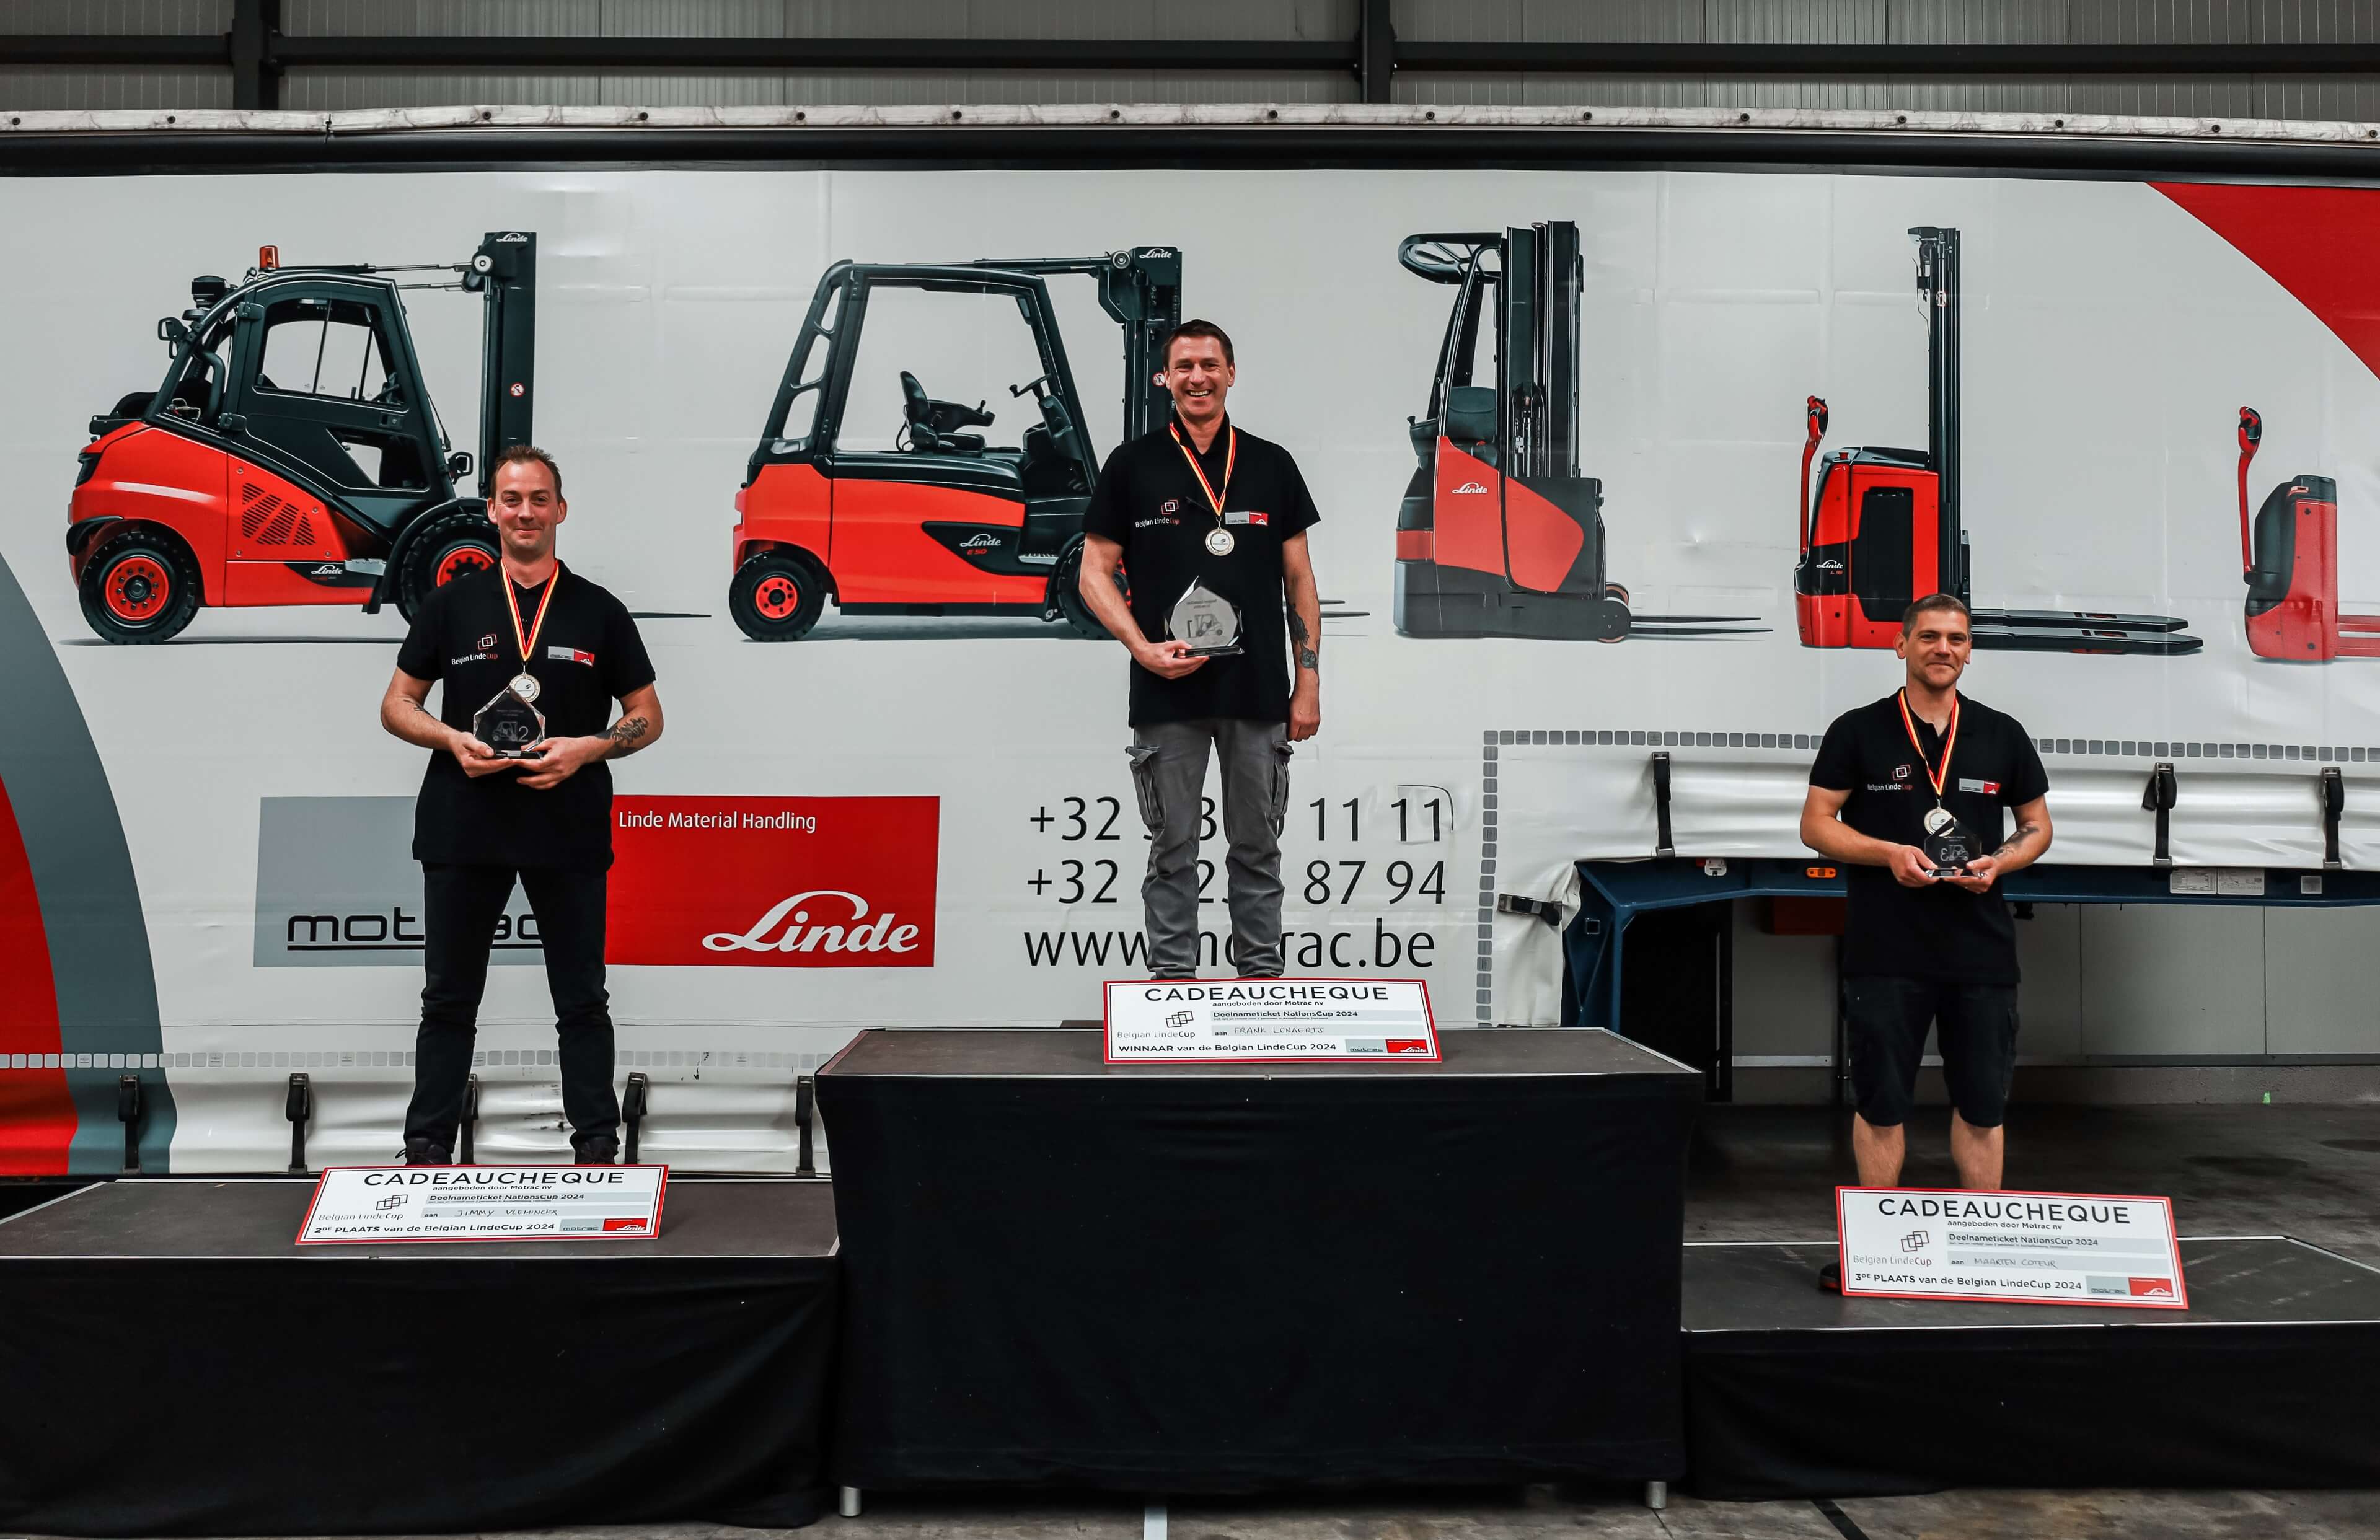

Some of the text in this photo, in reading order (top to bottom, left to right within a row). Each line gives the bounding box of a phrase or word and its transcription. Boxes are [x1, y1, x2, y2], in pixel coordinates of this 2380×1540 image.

[496, 232, 528, 242] Linde
[1139, 248, 1172, 258] Linde
[1452, 482, 1488, 494] Linde
[1135, 516, 1180, 528] Belgian LindeCup
[959, 534, 1002, 547] Linde
[311, 564, 343, 574] Linde
[1816, 560, 1844, 569] Linde
[518, 726, 529, 742] 2
[619, 811, 816, 834] Linde Material Handling
[1029, 796, 1121, 841] +32
[1309, 797, 1359, 842] 11
[1391, 798, 1440, 842] 11
[1027, 858, 1119, 904] +32
[1303, 859, 1446, 905] 87 94
[702, 890, 919, 953] Linde
[1145, 986, 1389, 1001] CADEAUCHEQUE
[1117, 1031, 1196, 1040] Belgian LindeCup
[1272, 1026, 1324, 1034] LENAERTS
[364, 1172, 625, 1186] CADEAUCHEQUE
[319, 1212, 403, 1221] Belgian LindeCup
[1879, 1199, 2131, 1225] CADEAUCHEQUE
[1947, 1220, 1998, 1228] aangeboden
[1949, 1233, 2019, 1243] Deelnameticket
[2021, 1236, 2073, 1246] NationsCup
[1853, 1255, 1932, 1267] Belgian LindeCup
[1974, 1257, 2016, 1266] MAARTEN
[1874, 1274, 1915, 1283] PLAATS
[1941, 1277, 1954, 1285] de
[1957, 1277, 1997, 1287] Belgian
[2000, 1278, 2051, 1290] LindeCup
[2055, 1281, 2082, 1290] 2024
